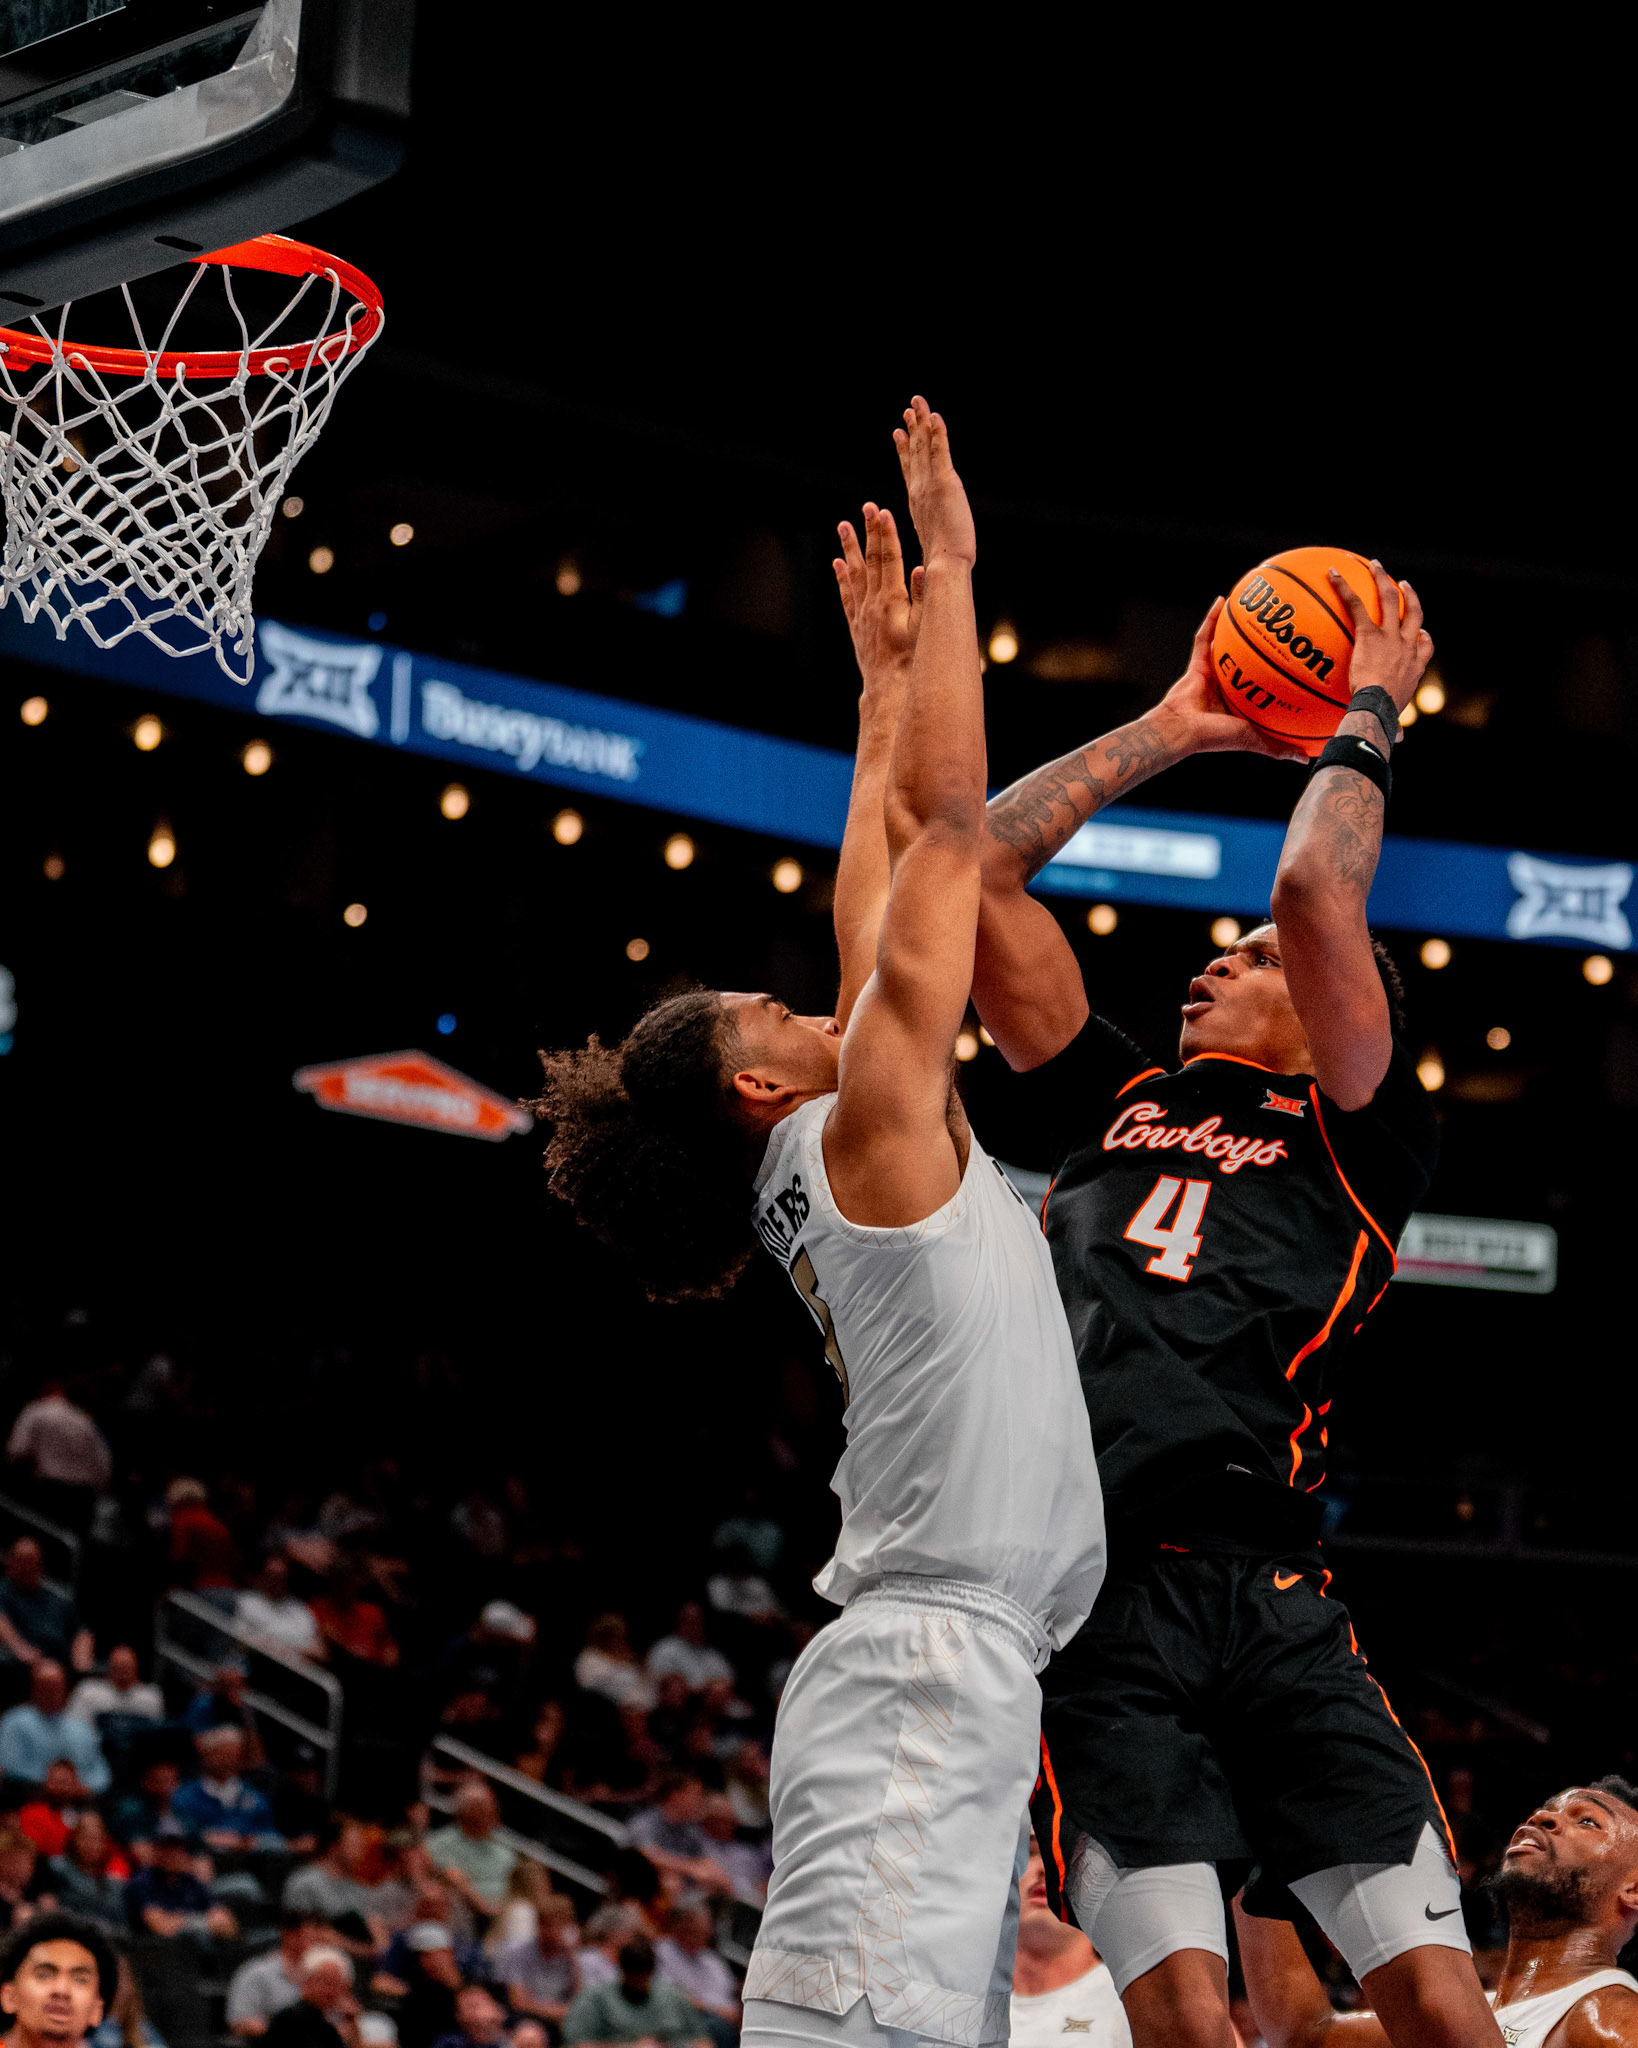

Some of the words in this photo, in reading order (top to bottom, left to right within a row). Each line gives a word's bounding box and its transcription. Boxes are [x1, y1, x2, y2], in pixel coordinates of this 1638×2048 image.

[1239, 575, 1335, 682] Wilson
[1218, 652, 1277, 710] EVO
[1276, 699, 1304, 714] NXT
[1102, 1101, 1288, 1174] Cowboys
[1123, 1174, 1212, 1283] 4
